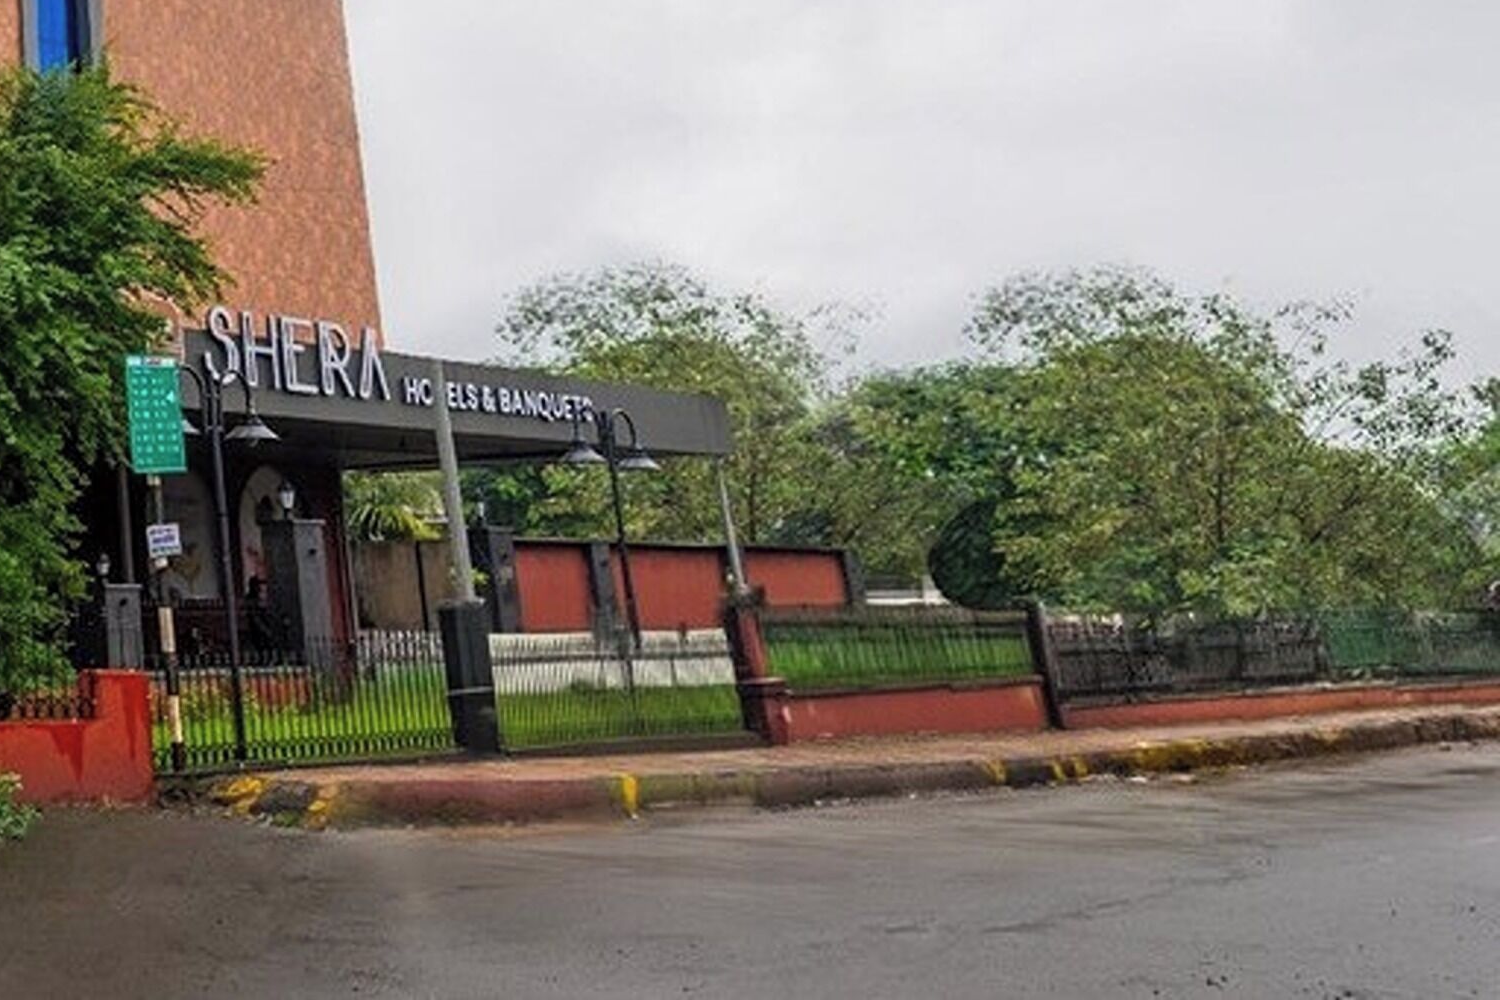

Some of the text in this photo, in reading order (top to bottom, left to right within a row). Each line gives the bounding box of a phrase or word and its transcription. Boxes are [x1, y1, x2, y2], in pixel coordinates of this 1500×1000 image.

[204, 305, 595, 422] SHERA HOELS & BANQUETS
